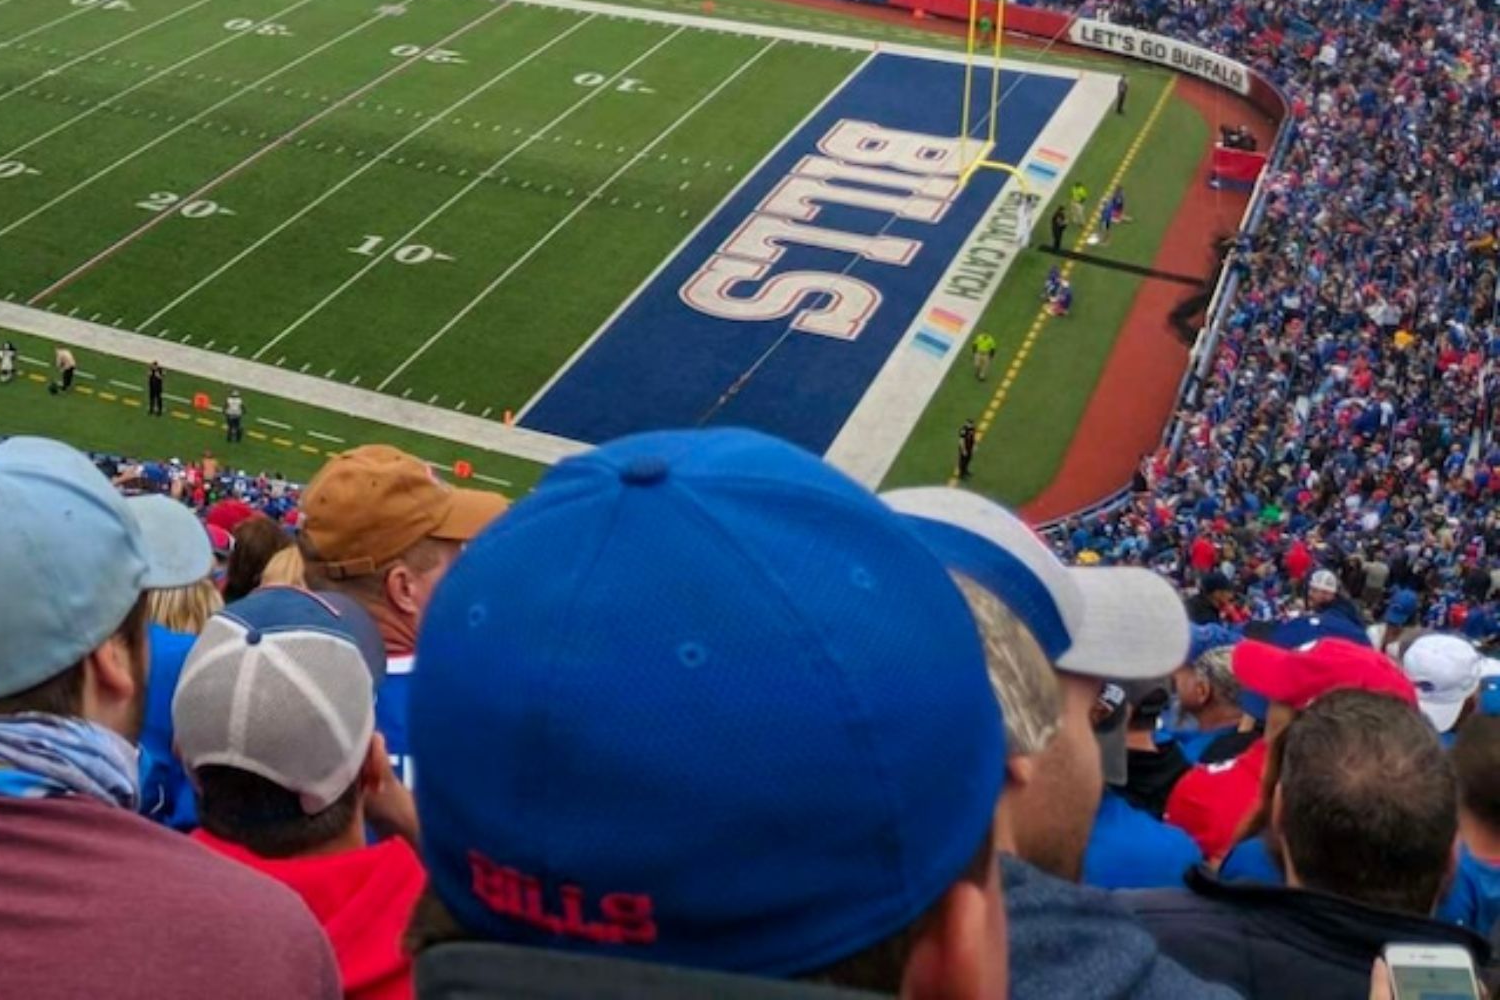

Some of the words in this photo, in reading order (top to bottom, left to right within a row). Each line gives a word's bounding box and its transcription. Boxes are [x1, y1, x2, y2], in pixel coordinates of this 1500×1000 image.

[1081, 26, 1134, 51] LET'S
[1140, 41, 1166, 60] GO
[136, 191, 219, 218] 20
[347, 234, 436, 265] 10
[678, 118, 996, 341] BILLS
[944, 246, 1006, 301] CATCH
[468, 848, 658, 945] BILLS
